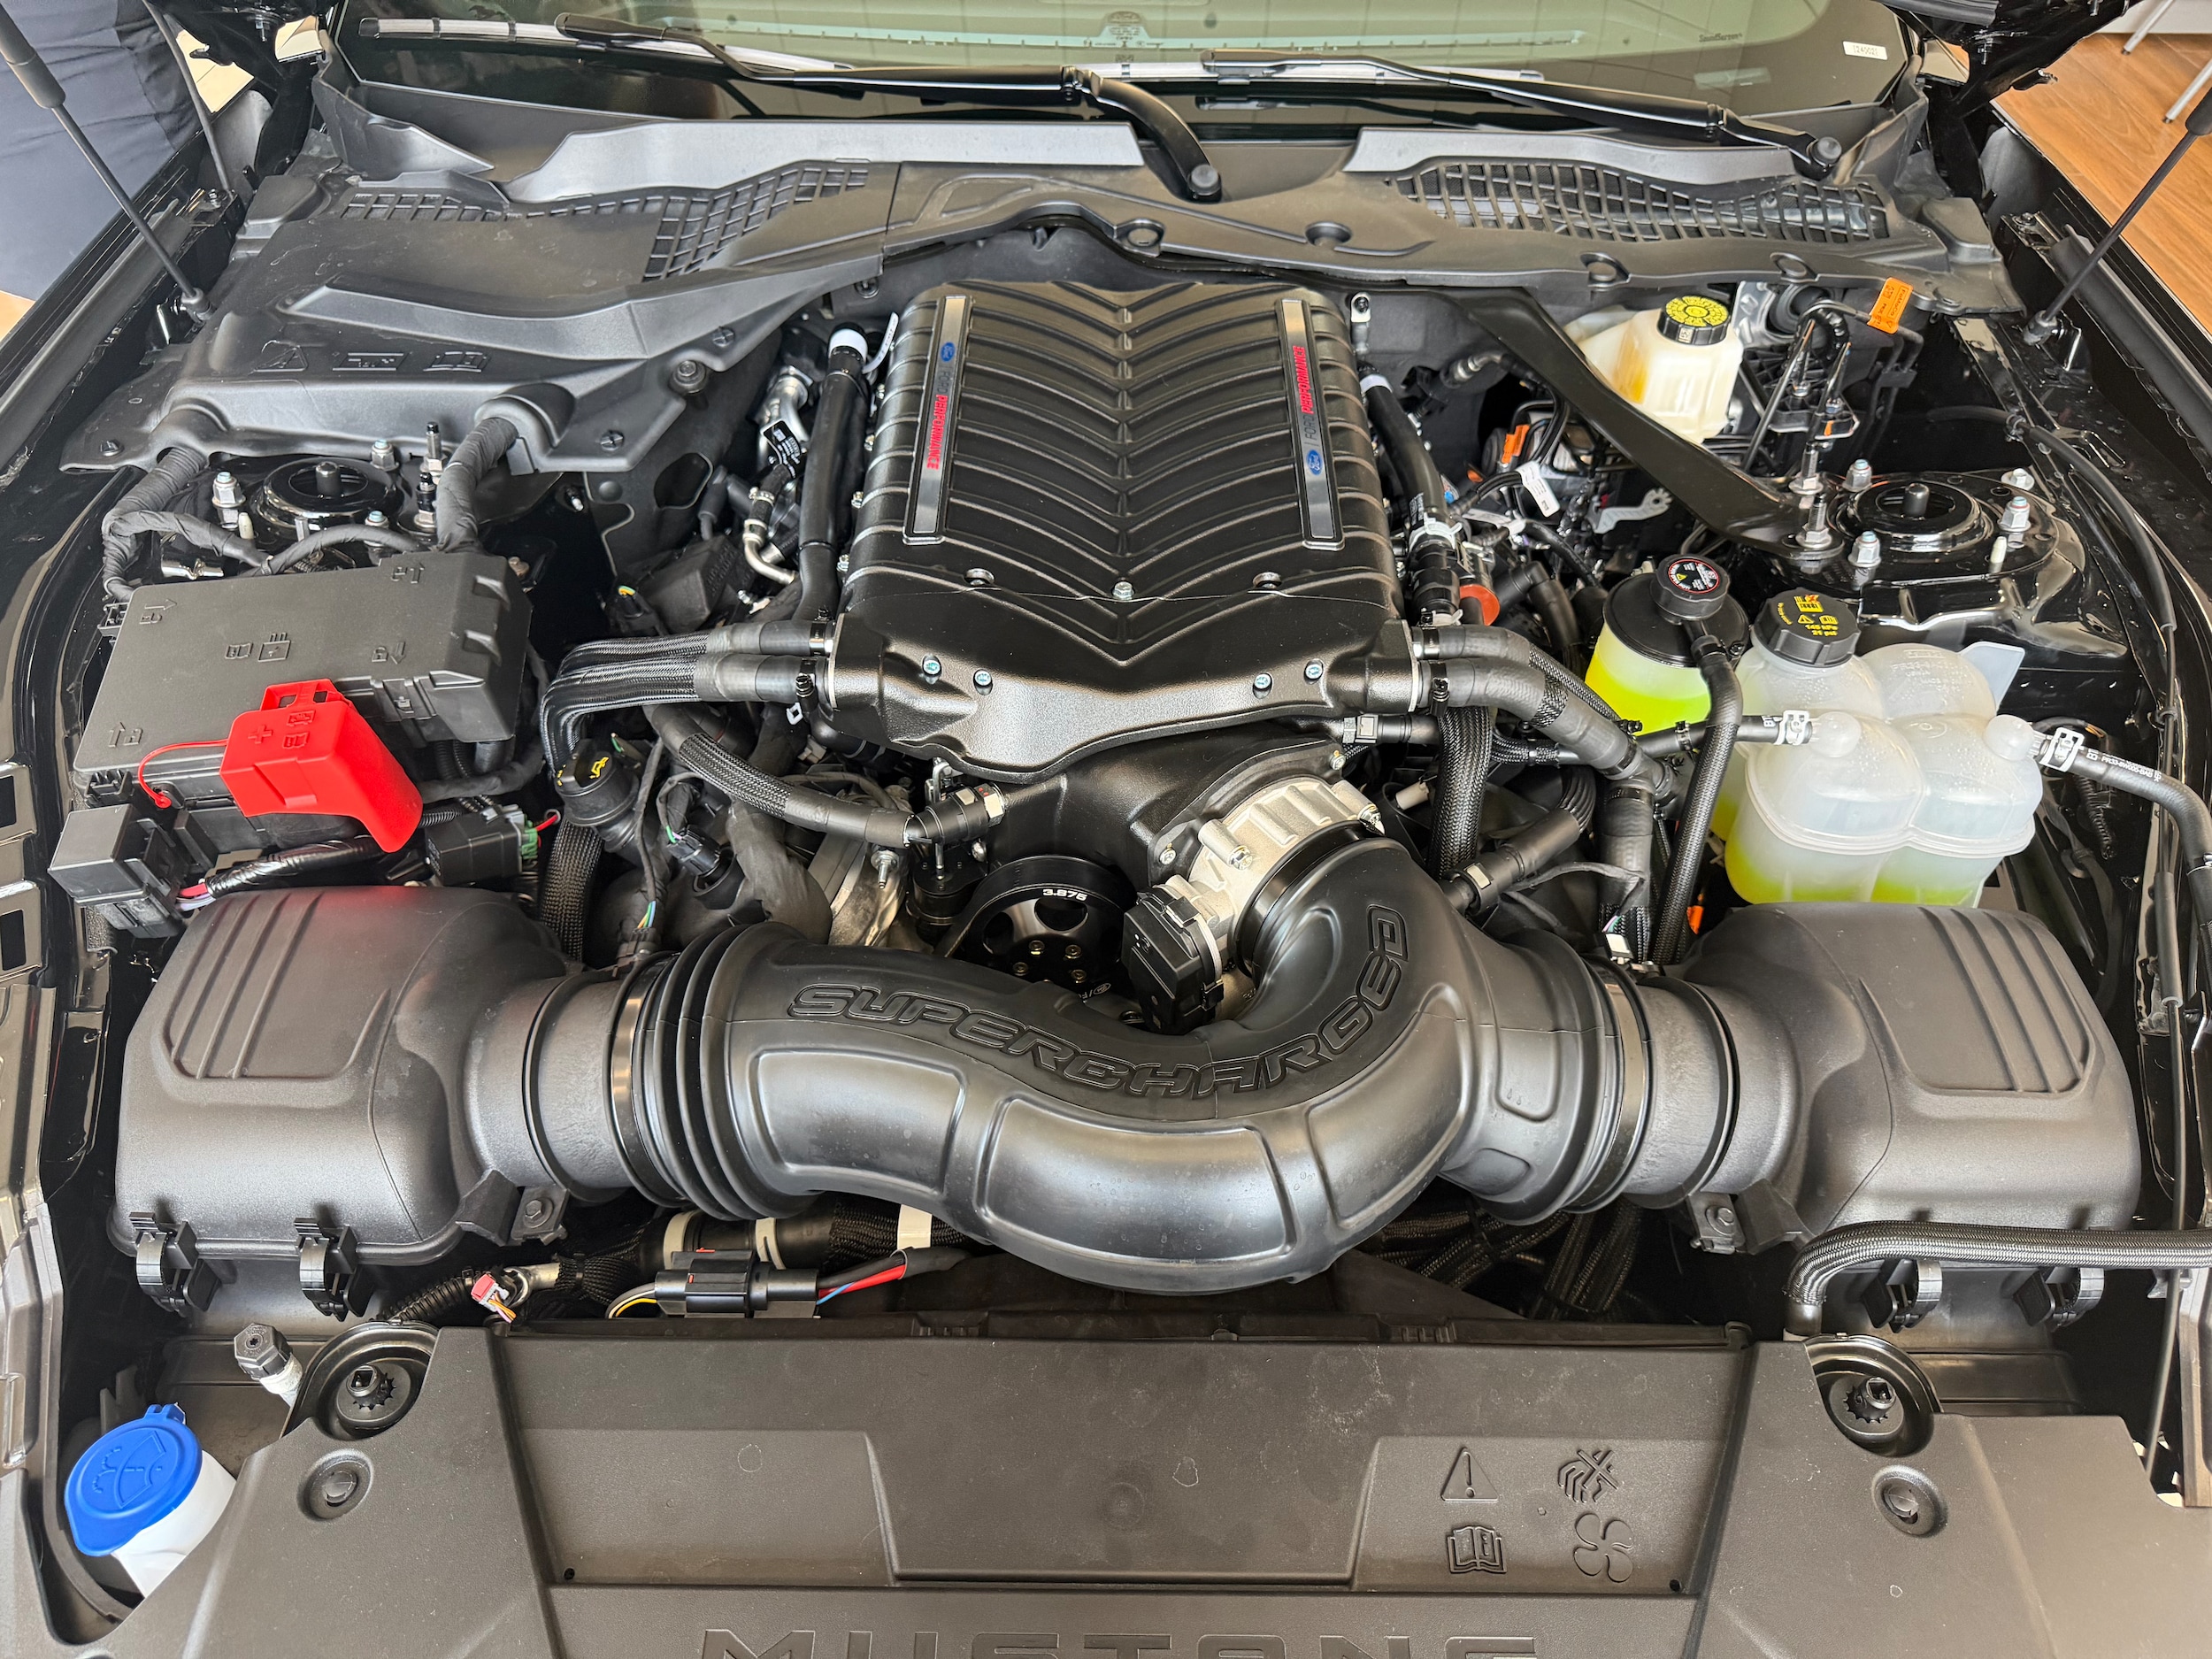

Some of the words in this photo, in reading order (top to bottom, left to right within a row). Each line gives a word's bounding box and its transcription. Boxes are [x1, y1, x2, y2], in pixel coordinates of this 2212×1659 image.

[1891, 289, 1906, 316] FoMoCo
[941, 342, 955, 361] Ford
[938, 369, 951, 395] FORD
[1293, 345, 1314, 414] PERFORMANCE
[926, 395, 949, 471] PERFORMANCE
[1303, 415, 1318, 441] FORD
[1307, 450, 1322, 474] Ford
[1043, 888, 1087, 901] 3.875
[787, 904, 1409, 1100] SUPERCHARGED
